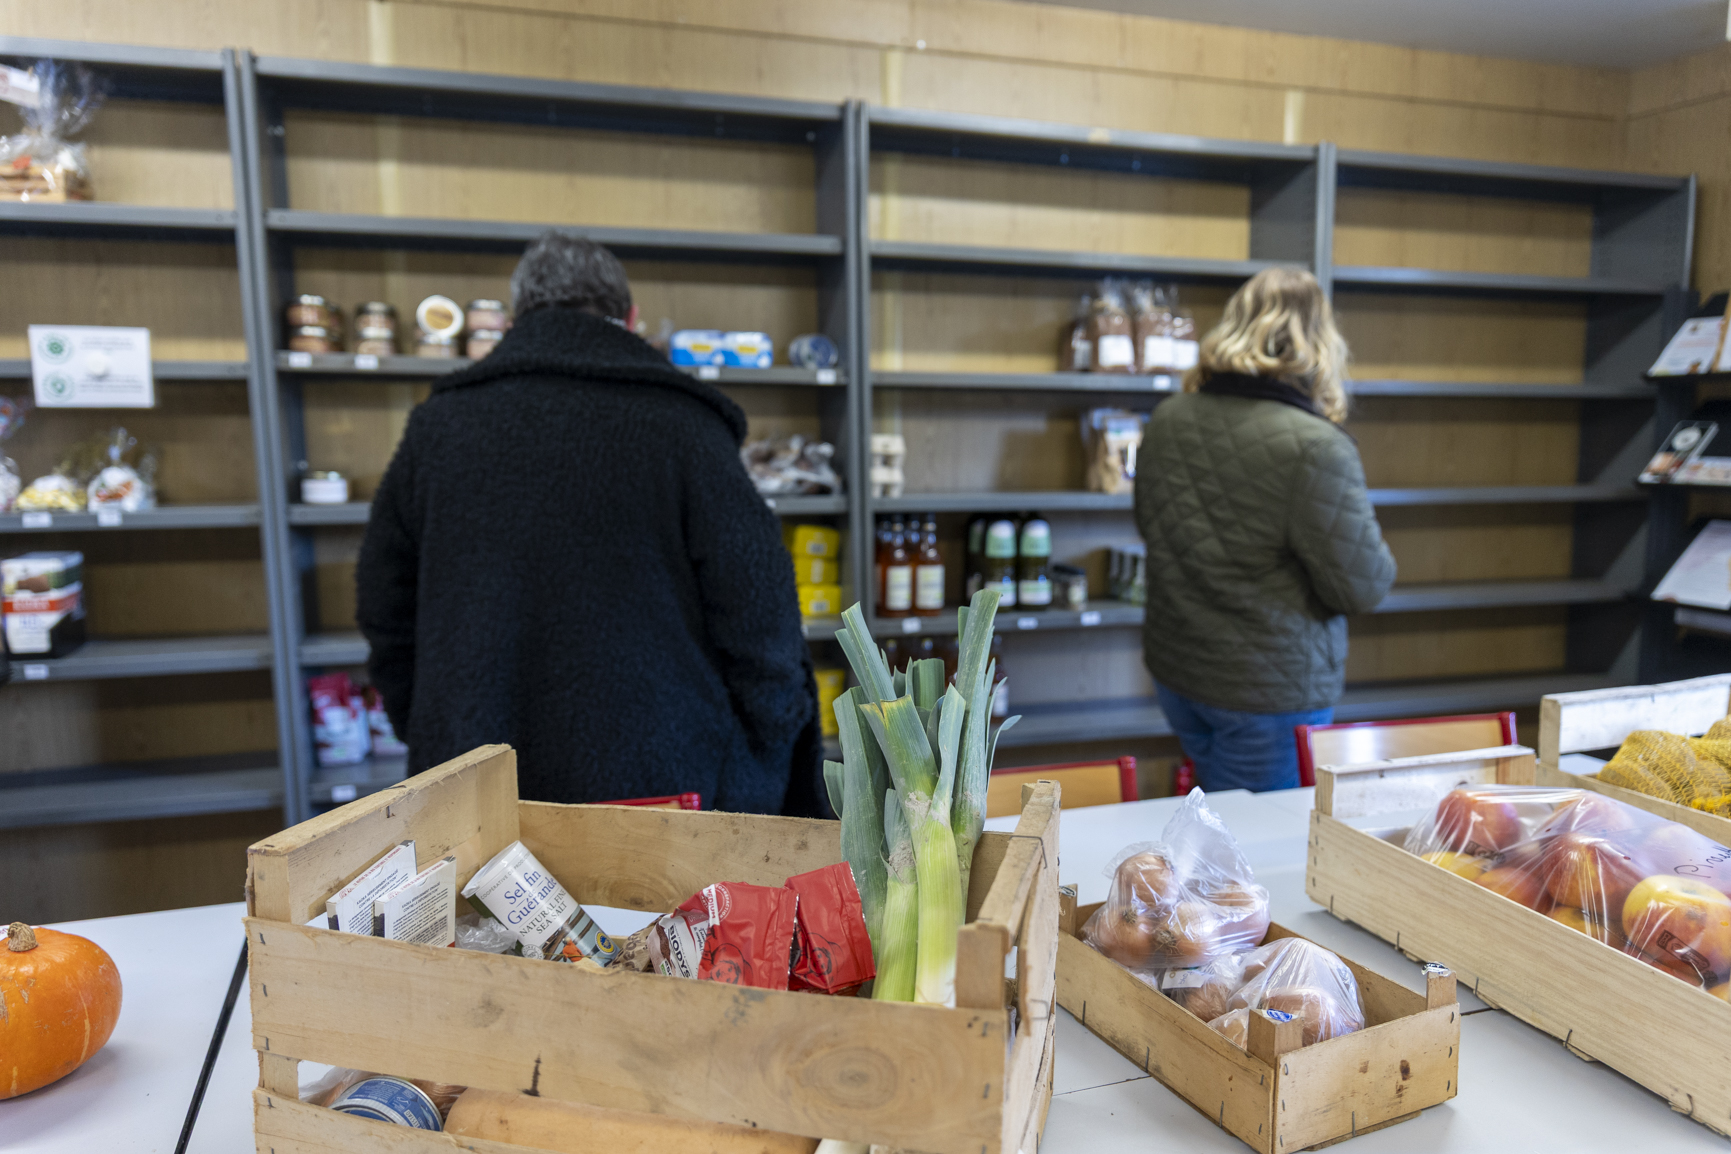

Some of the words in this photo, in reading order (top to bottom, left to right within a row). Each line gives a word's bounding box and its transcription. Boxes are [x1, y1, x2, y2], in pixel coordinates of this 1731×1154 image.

[504, 882, 526, 905] Sel
[523, 870, 542, 887] fin
[507, 876, 557, 925] Guérande
[528, 888, 537, 897] de
[706, 887, 716, 919] MEDIUM
[519, 902, 557, 937] NATURAL
[555, 888, 567, 904] FINE
[536, 917, 554, 935] SEA
[551, 901, 568, 920] SALT
